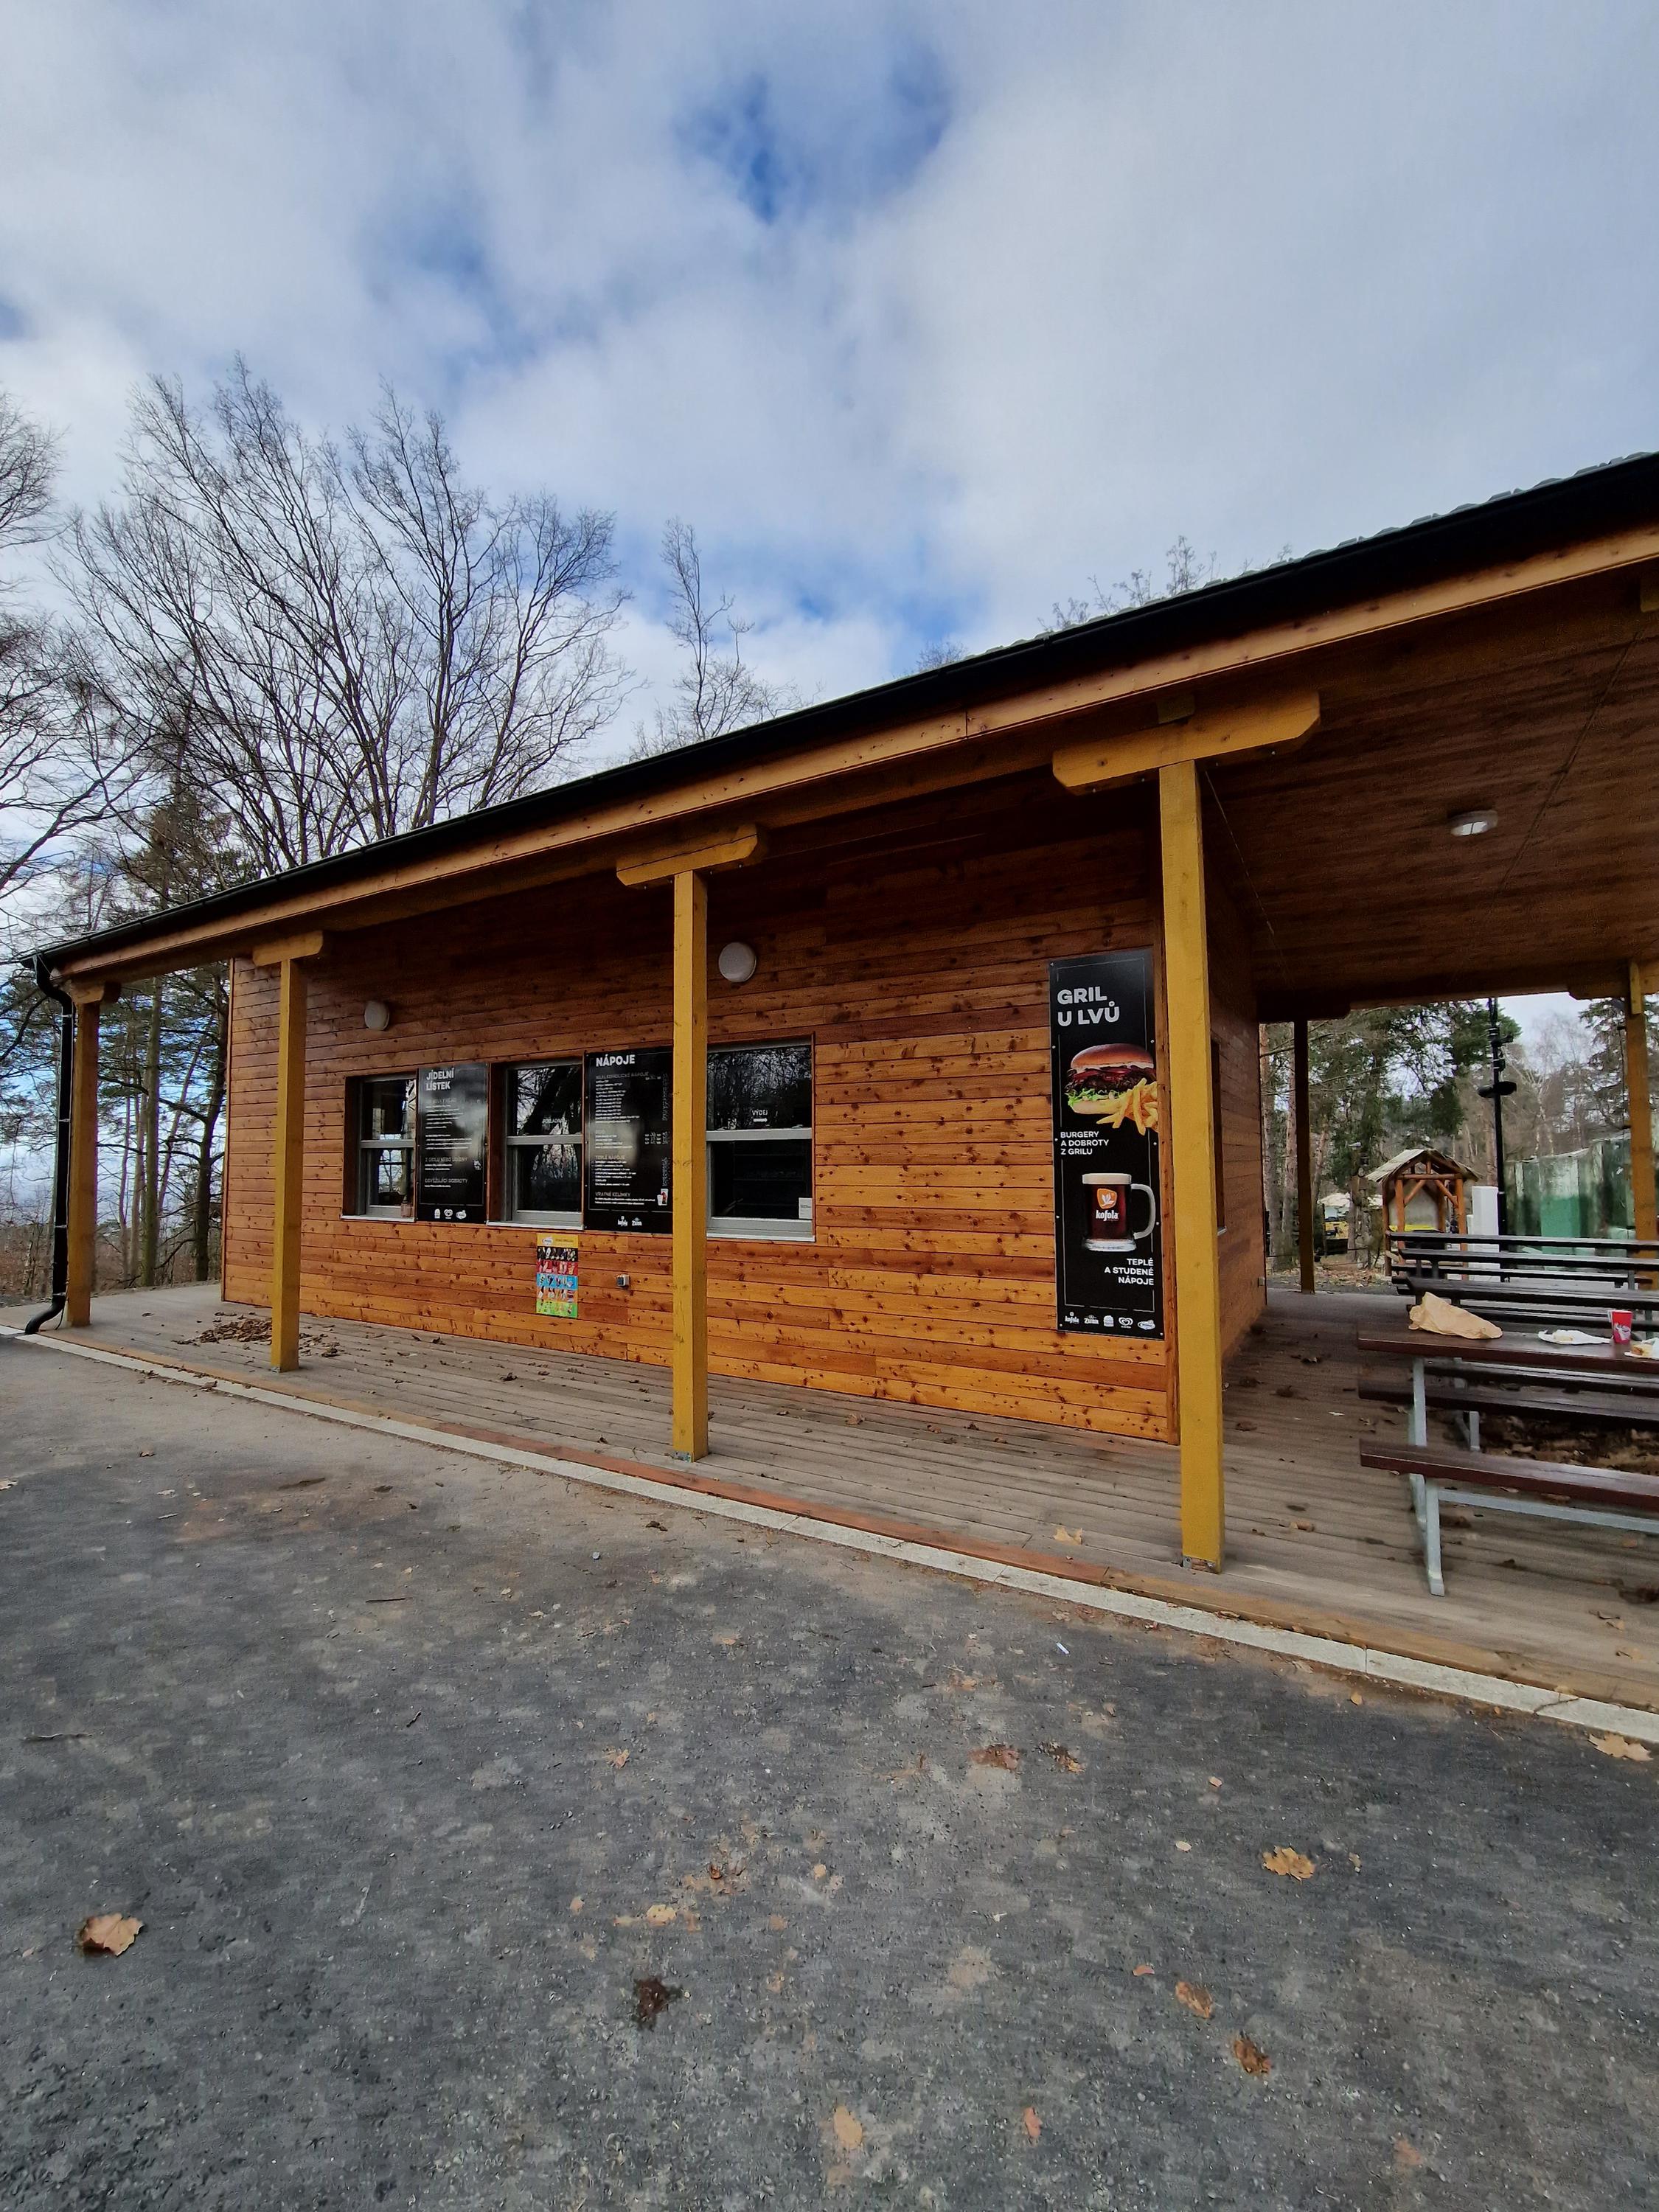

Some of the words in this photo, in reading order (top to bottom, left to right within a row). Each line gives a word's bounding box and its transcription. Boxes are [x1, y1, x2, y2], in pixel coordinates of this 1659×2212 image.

[1057, 986, 1107, 1005] GRIL
[1057, 1010, 1072, 1026] U
[1077, 1001, 1120, 1025] LVŮ
[596, 1054, 636, 1067] NÁPOJE
[426, 1068, 455, 1080] JÍDELNÍ
[426, 1080, 451, 1091] LÍSTEK
[1096, 1209, 1119, 1221] kofola
[1127, 1258, 1154, 1267] TEPLÉ
[1113, 1267, 1154, 1276] STUDENÉ
[1118, 1276, 1154, 1285] NÁPOJE
